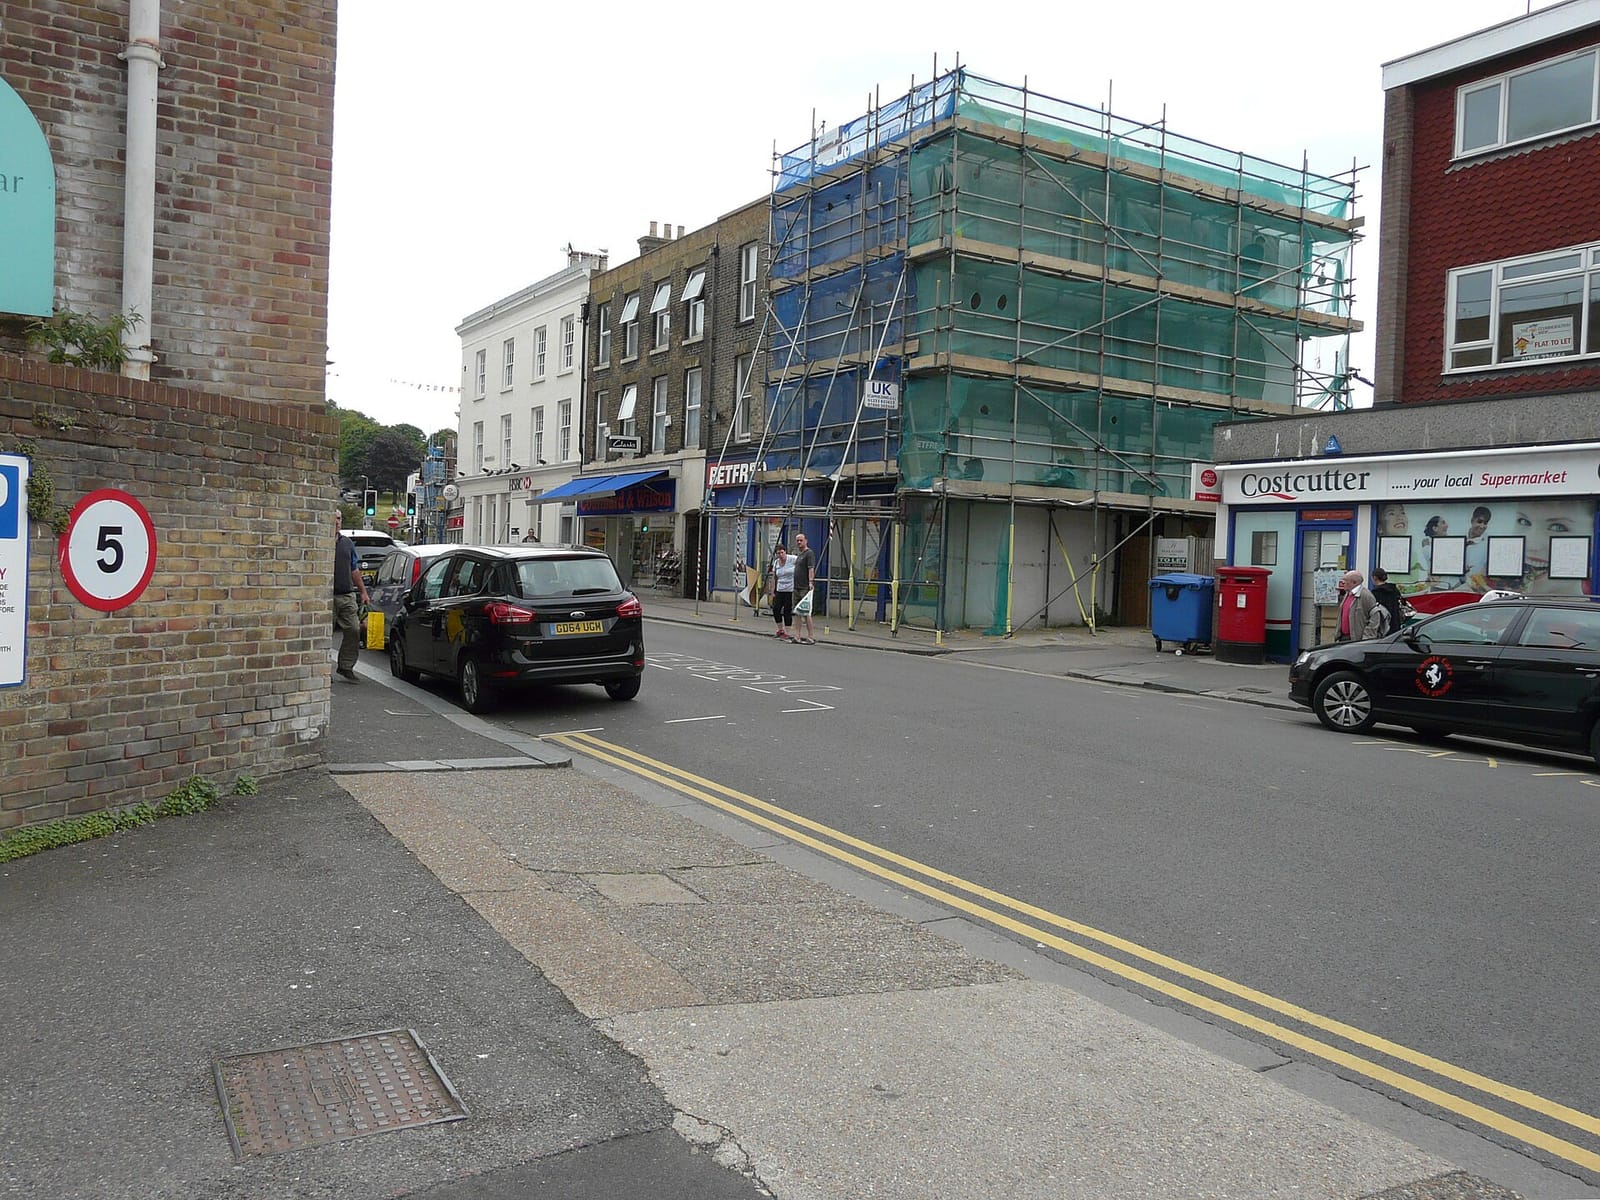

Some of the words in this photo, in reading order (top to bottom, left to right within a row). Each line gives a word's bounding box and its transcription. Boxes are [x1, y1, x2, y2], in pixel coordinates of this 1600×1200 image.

[1534, 340, 1549, 348] FLAT
[1551, 338, 1559, 346] TO
[1560, 337, 1571, 345] LET
[872, 382, 891, 396] UK
[612, 439, 636, 448] Clarks
[1240, 467, 1371, 497] Costcutter
[1444, 474, 1473, 487] local
[1480, 471, 1567, 488] Supermarket
[96, 526, 124, 573] 5
[556, 623, 581, 633] GD64
